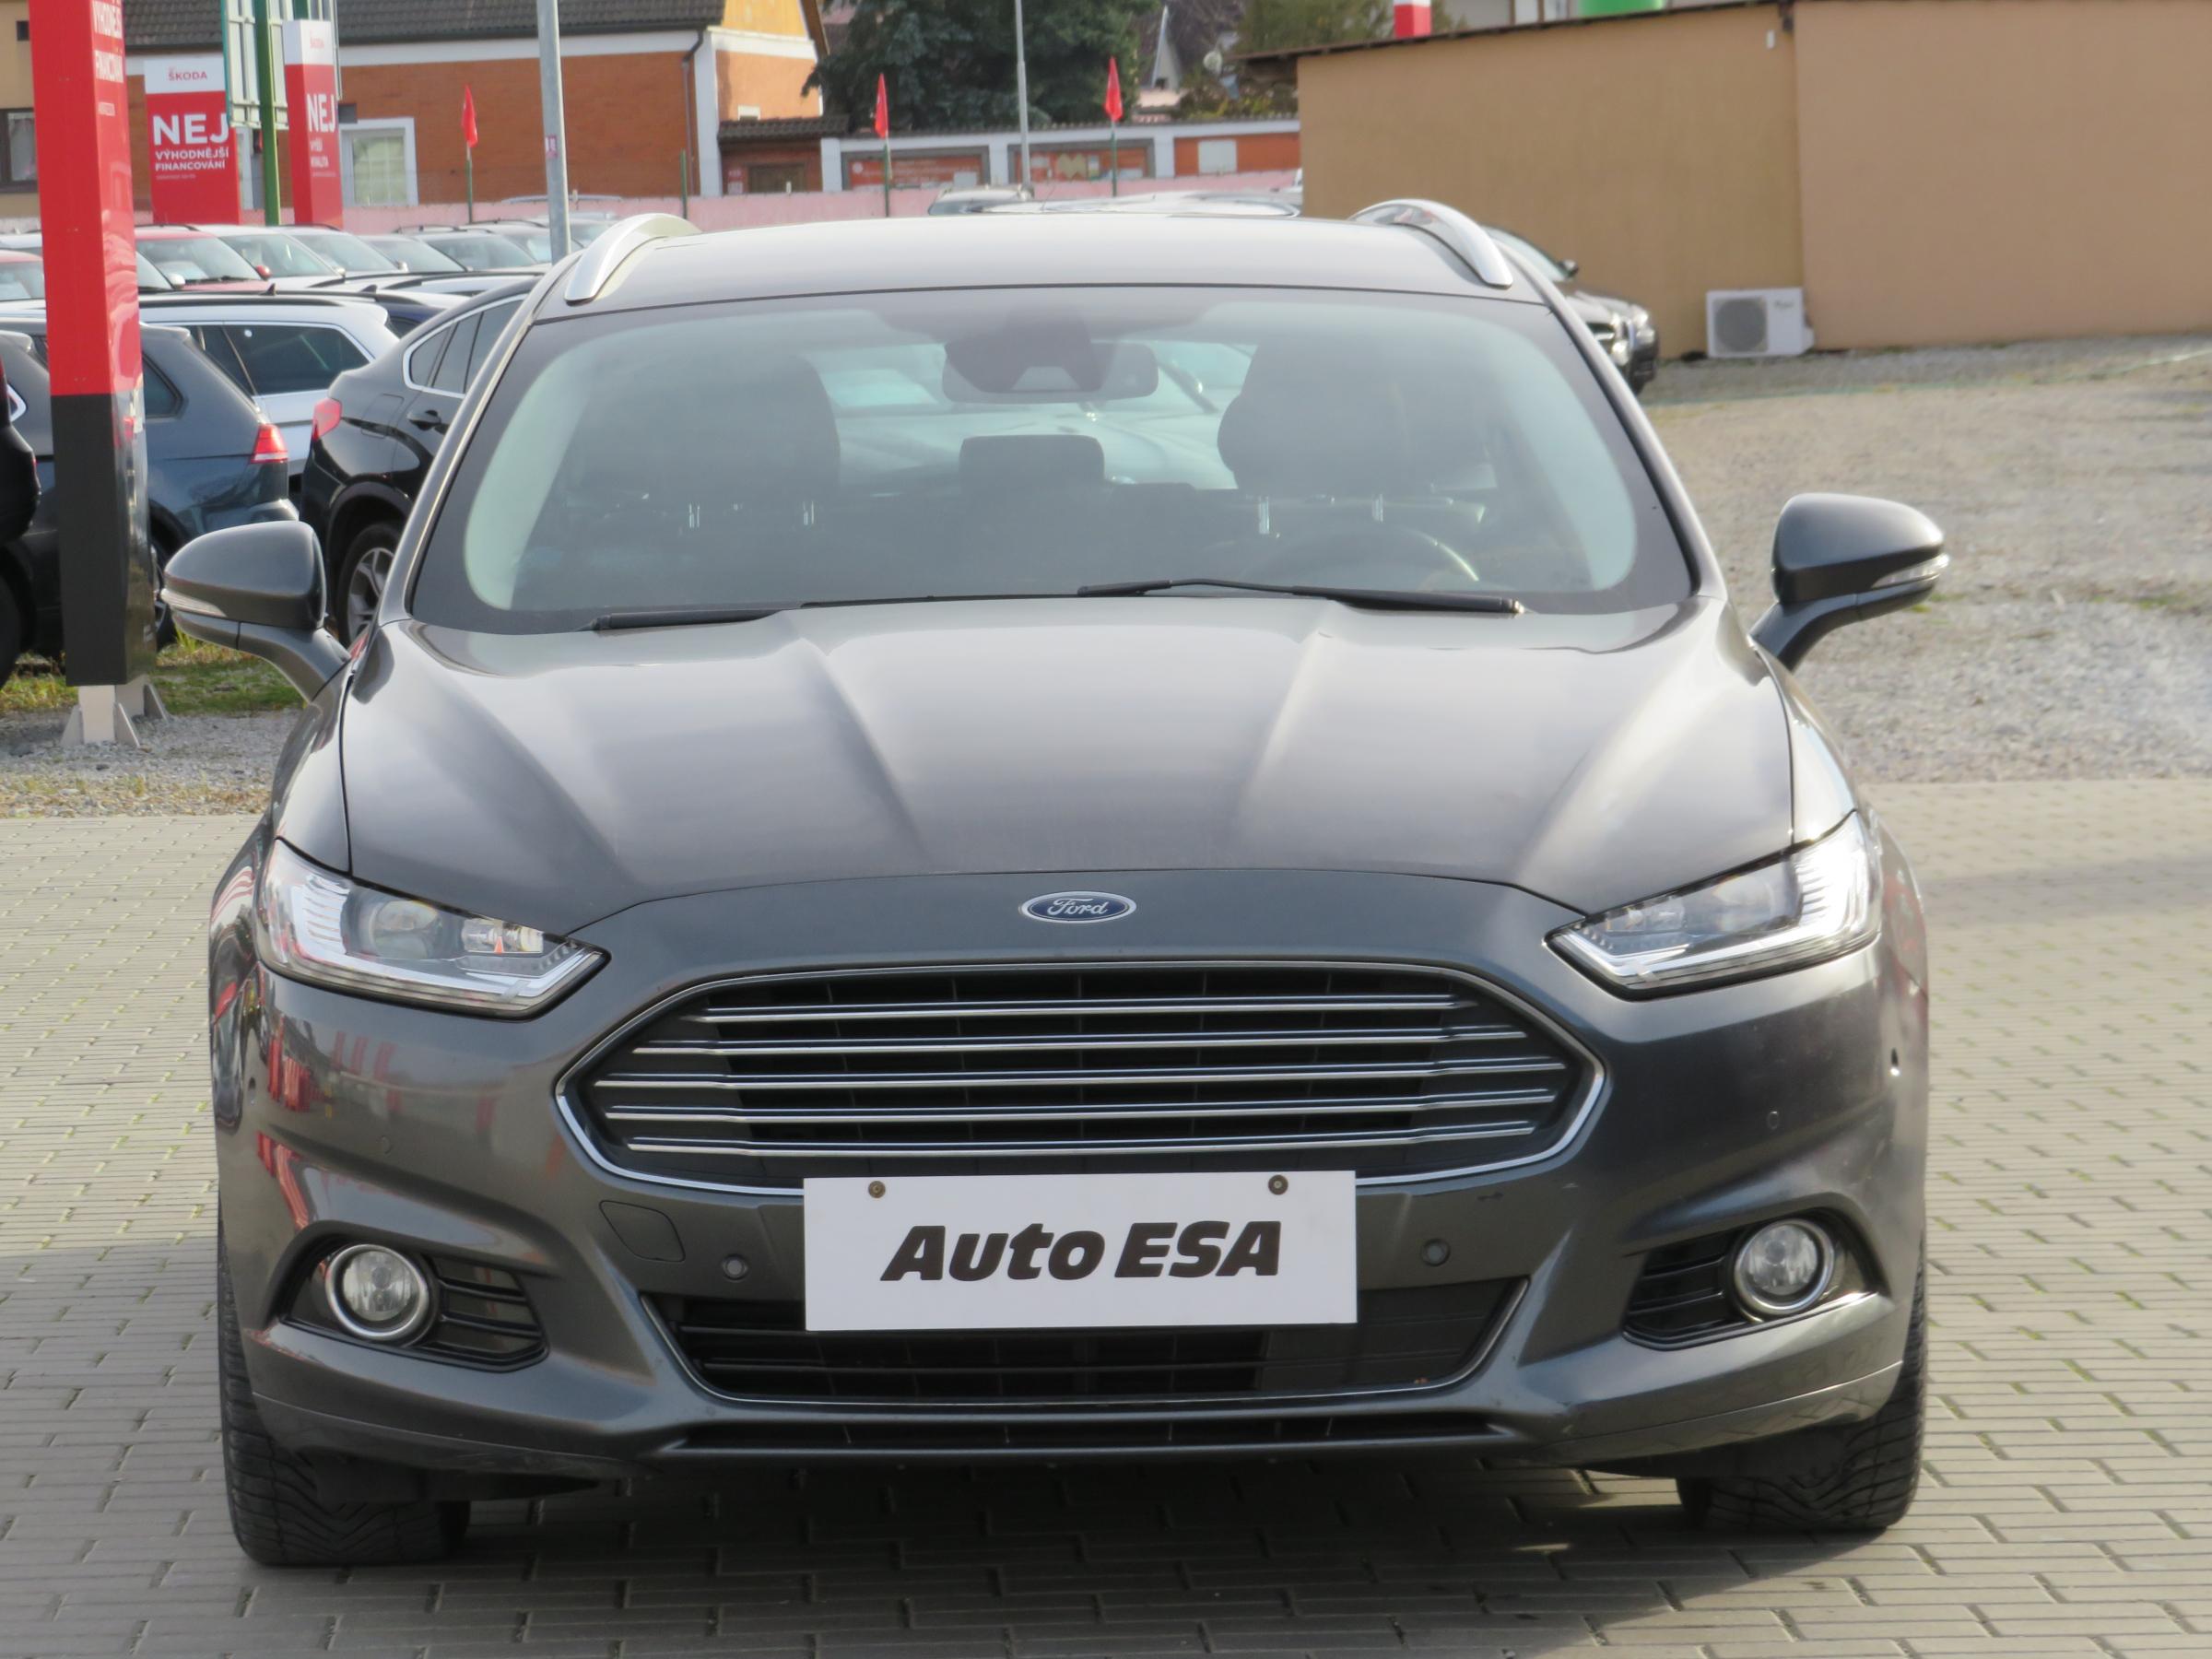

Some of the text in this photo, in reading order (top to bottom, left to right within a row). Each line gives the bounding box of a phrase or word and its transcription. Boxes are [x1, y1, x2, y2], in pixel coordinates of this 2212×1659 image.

[168, 67, 207, 81] ŠKODA
[306, 93, 335, 133] NEJ
[152, 112, 229, 146] NEJ
[155, 147, 229, 160] VÝHODNĚJŠÍ
[155, 159, 226, 172] FINANCOVÁNÍ
[1046, 898, 1110, 916] Ford
[879, 1220, 1282, 1282] Auto ESA
